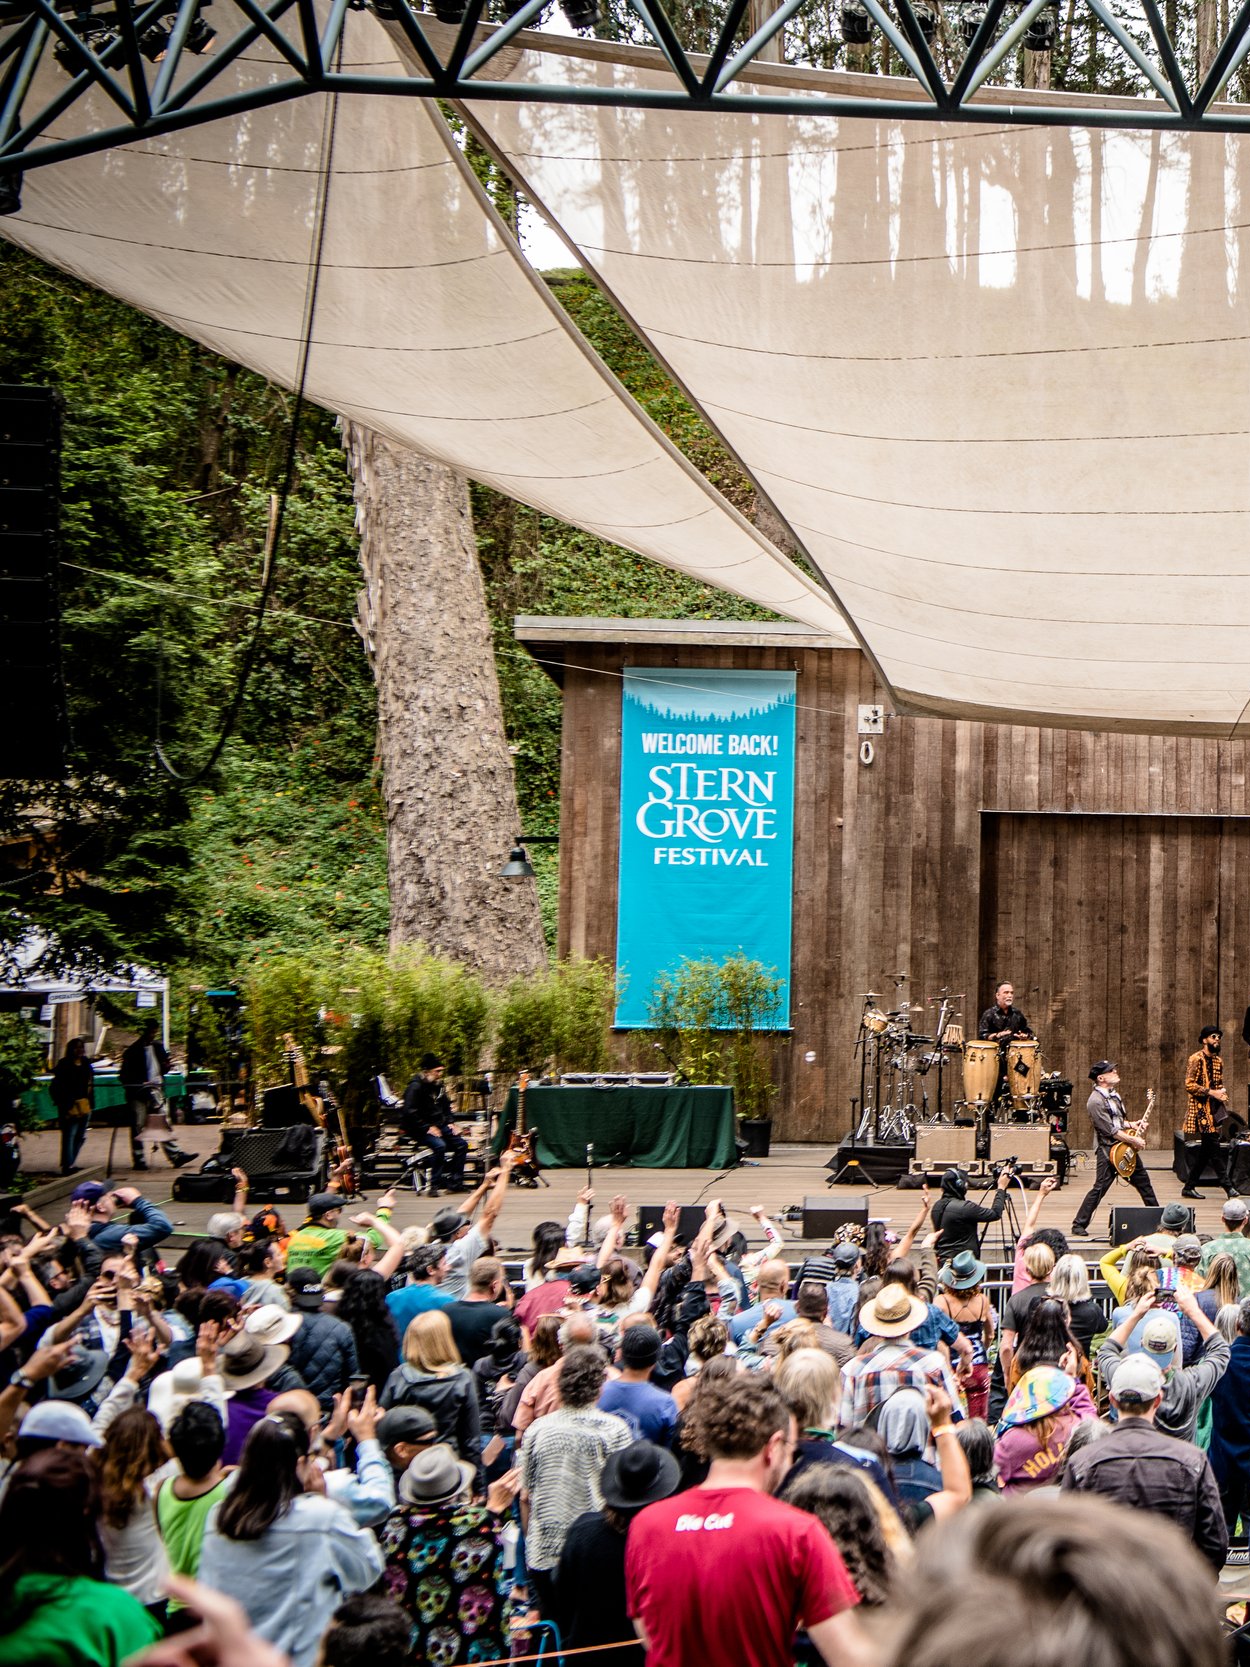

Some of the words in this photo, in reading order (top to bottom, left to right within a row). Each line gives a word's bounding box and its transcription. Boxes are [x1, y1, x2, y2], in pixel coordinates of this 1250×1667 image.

[641, 733, 723, 755] WELCOME
[728, 734, 779, 756] BACK!
[648, 763, 778, 807] STERN
[635, 799, 778, 843] GROVE
[653, 847, 769, 866] FESTIVAL
[1022, 1442, 1065, 1479] HOL
[675, 1513, 705, 1532] Die
[703, 1511, 735, 1531] Cut
